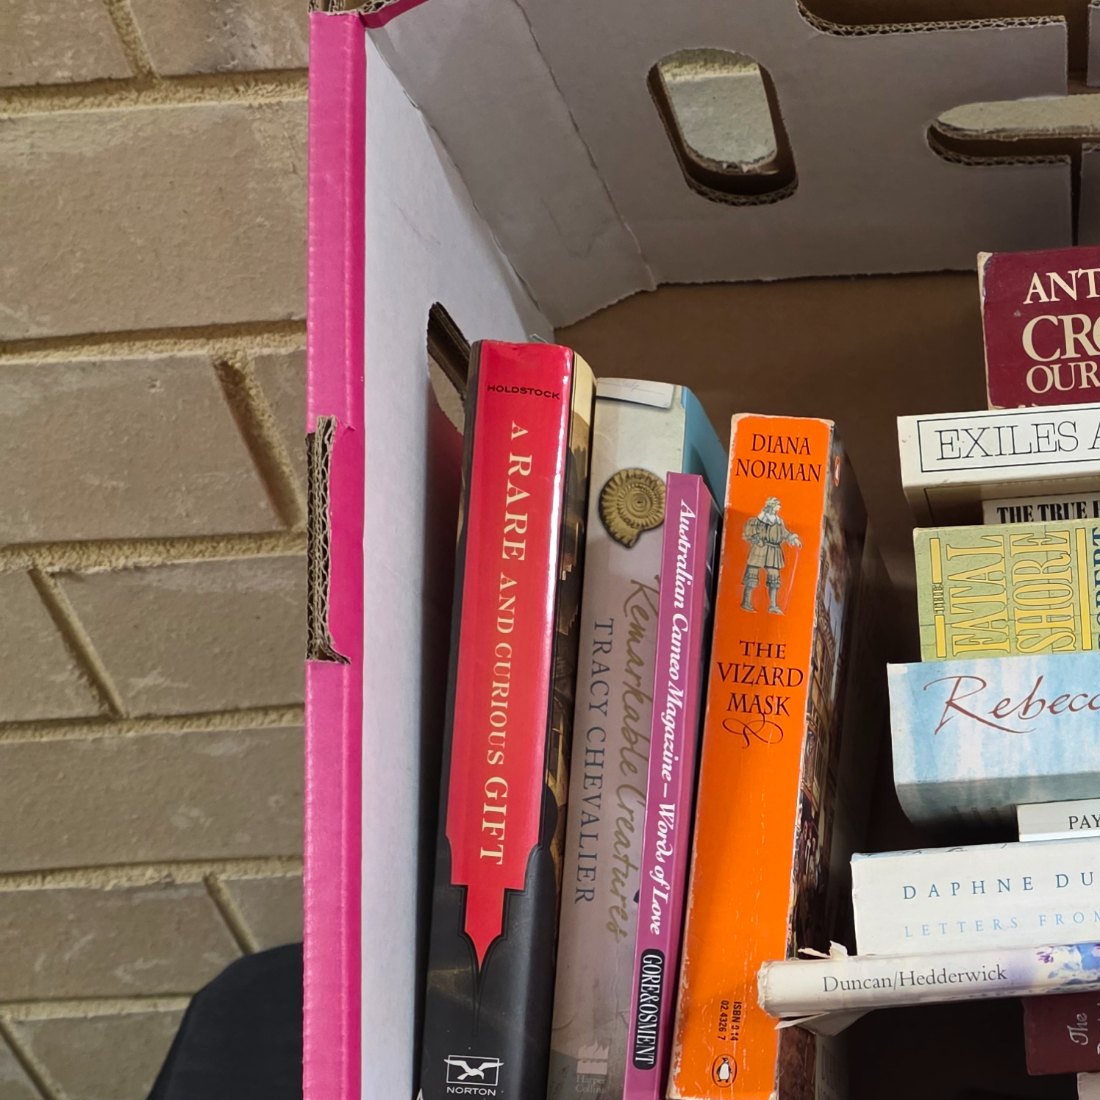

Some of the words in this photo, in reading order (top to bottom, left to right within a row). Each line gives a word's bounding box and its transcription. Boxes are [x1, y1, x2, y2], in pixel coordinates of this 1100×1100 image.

[487, 383, 560, 400] HOLDSTOCK
[751, 433, 811, 456] DIANA
[935, 420, 1079, 461] EXILES
[735, 458, 822, 483] NORMAN
[946, 534, 1010, 657] FATAL
[1010, 530, 1078, 654] SHORE
[739, 640, 786, 660] THE
[588, 618, 615, 718] TRACY
[717, 662, 804, 688] VIZARD
[727, 691, 791, 720] MASK
[575, 726, 607, 905] CHEVALIER
[902, 876, 1034, 900] DAPHNE
[1055, 871, 1095, 889] DU
[903, 916, 1020, 938] LETTERS
[822, 964, 1008, 993] Duncan/Hedderwick
[446, 1086, 496, 1097] NORTON
